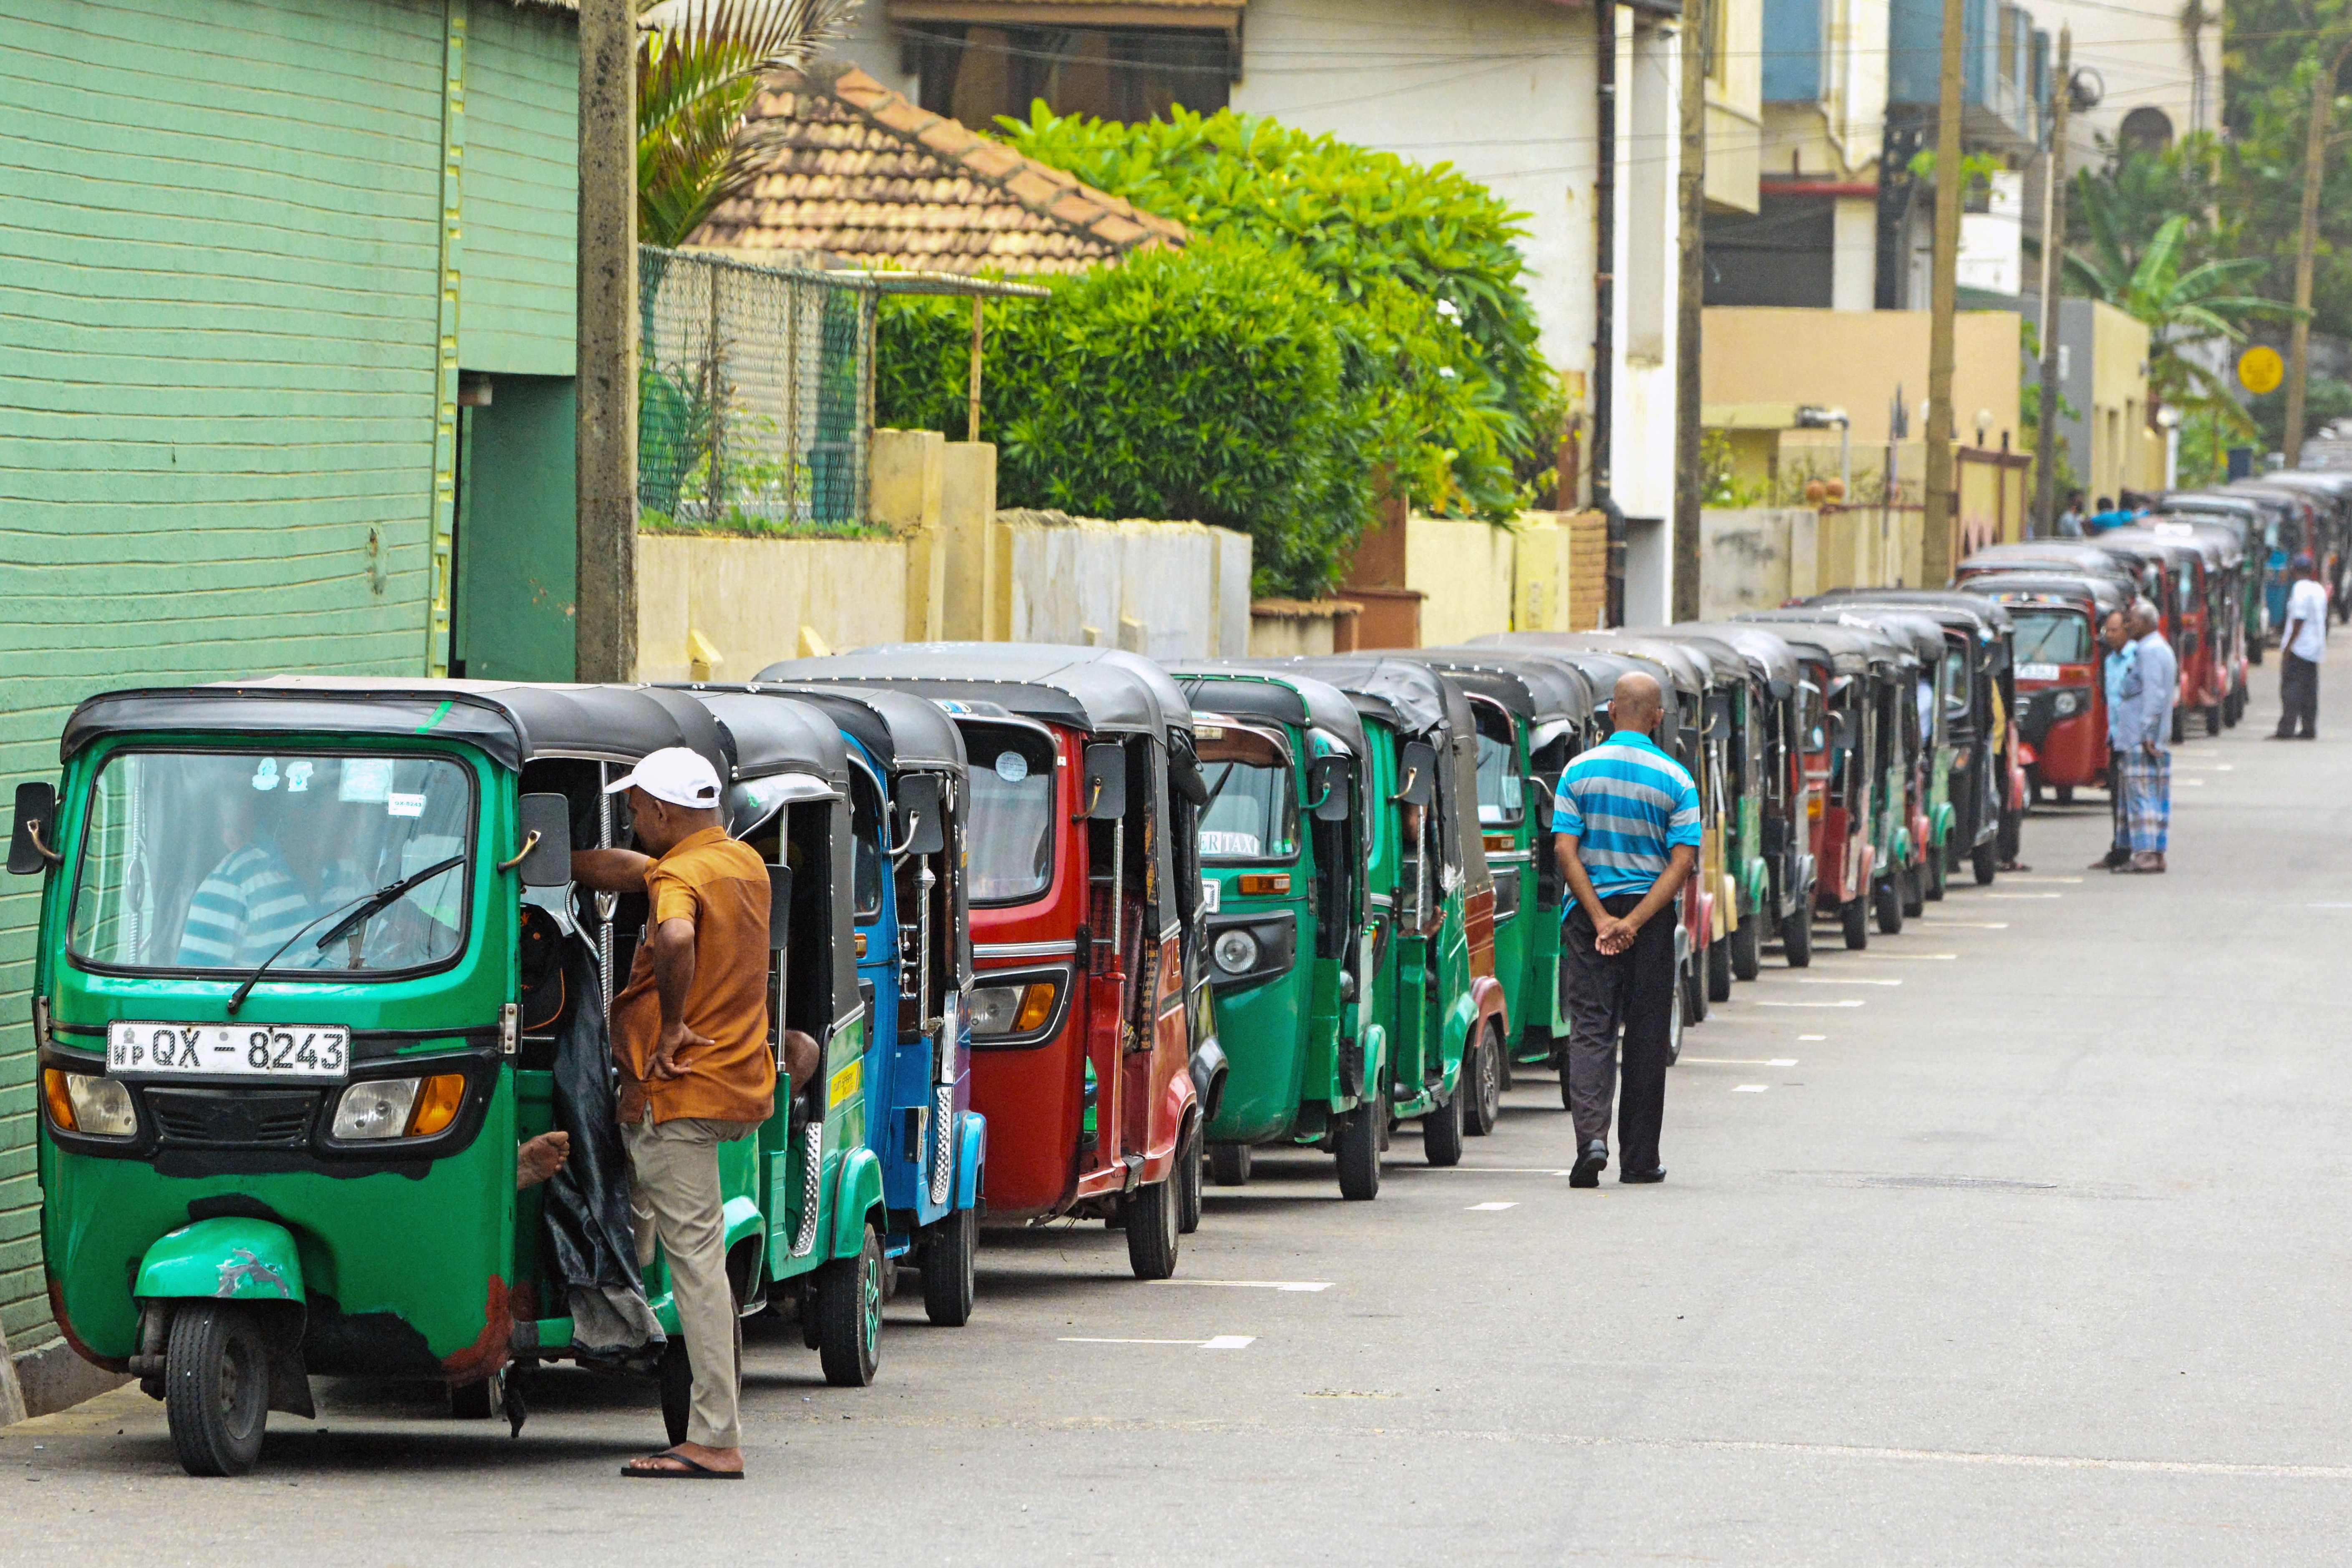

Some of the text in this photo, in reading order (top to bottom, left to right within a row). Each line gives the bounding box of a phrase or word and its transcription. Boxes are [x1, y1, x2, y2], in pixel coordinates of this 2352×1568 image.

[1223, 834, 1257, 854] TAXI
[152, 1030, 201, 1067] QX
[249, 1032, 343, 1069] 8243
